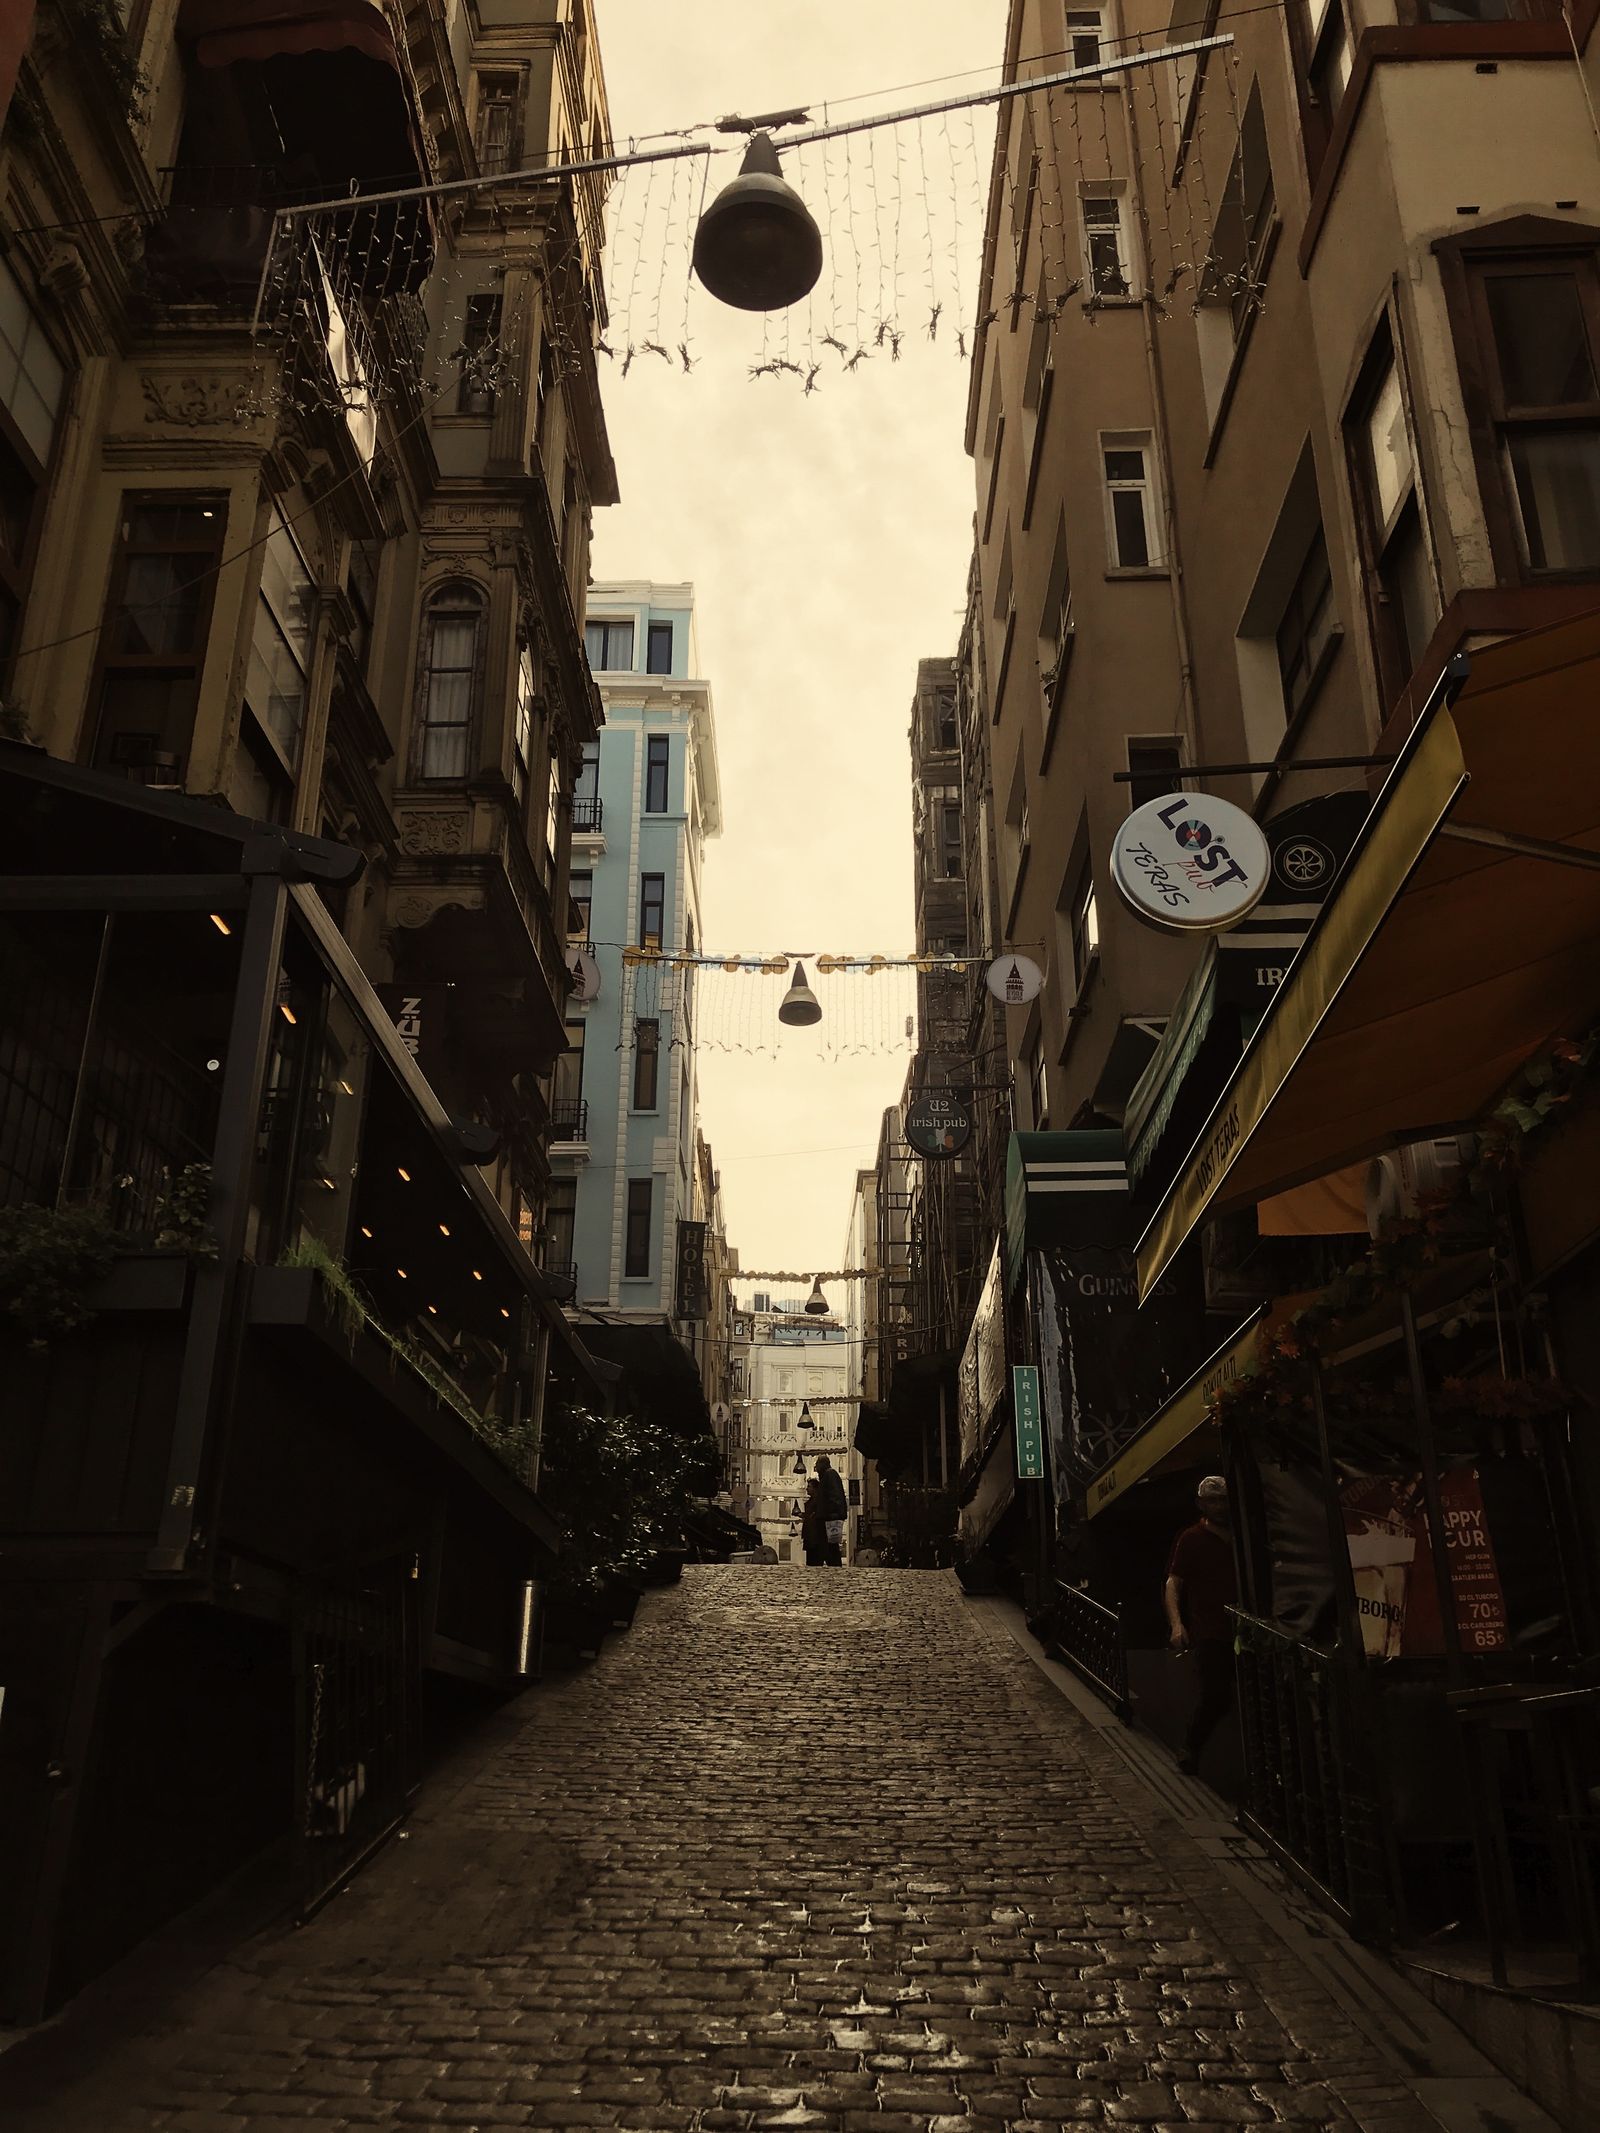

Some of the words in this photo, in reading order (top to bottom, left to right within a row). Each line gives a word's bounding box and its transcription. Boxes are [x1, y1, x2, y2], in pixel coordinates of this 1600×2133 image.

[1126, 842, 1190, 907] TERAS
[1157, 798, 1249, 888] LOST
[912, 1117, 941, 1127] irish
[943, 1116, 967, 1129] pub
[930, 1100, 950, 1112] U2
[1196, 1146, 1215, 1198] LOST
[1214, 1103, 1240, 1166] TERAS
[683, 1230, 698, 1313] HOTEL
[1022, 1368, 1034, 1429] IRISH
[1025, 1441, 1036, 1476] PUB
